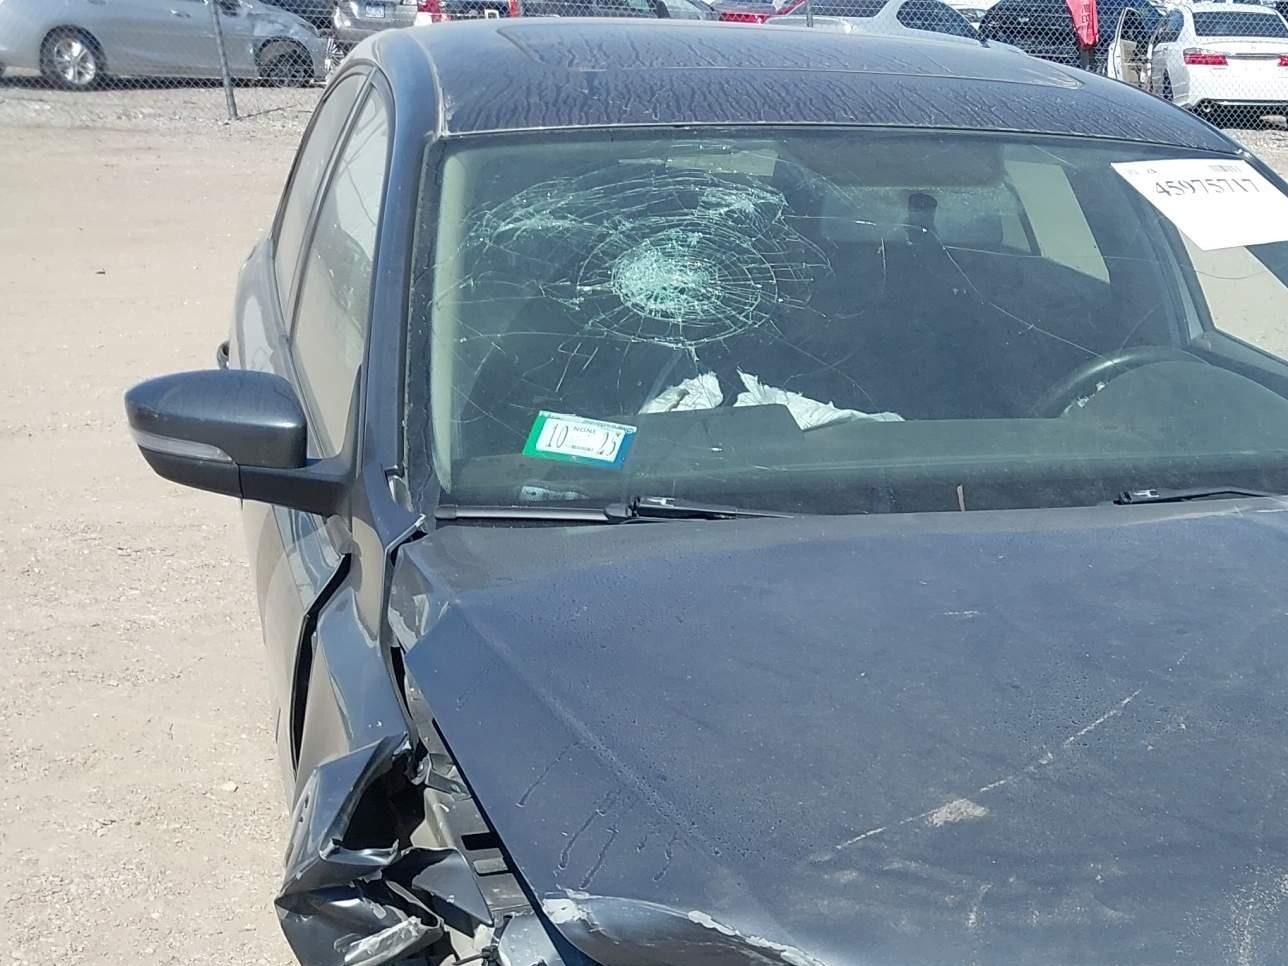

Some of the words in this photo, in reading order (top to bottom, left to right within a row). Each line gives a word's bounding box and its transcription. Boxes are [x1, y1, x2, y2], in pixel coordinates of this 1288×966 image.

[1154, 178, 1260, 197] 45975717
[546, 423, 569, 449] 10
[597, 431, 620, 457] 25
